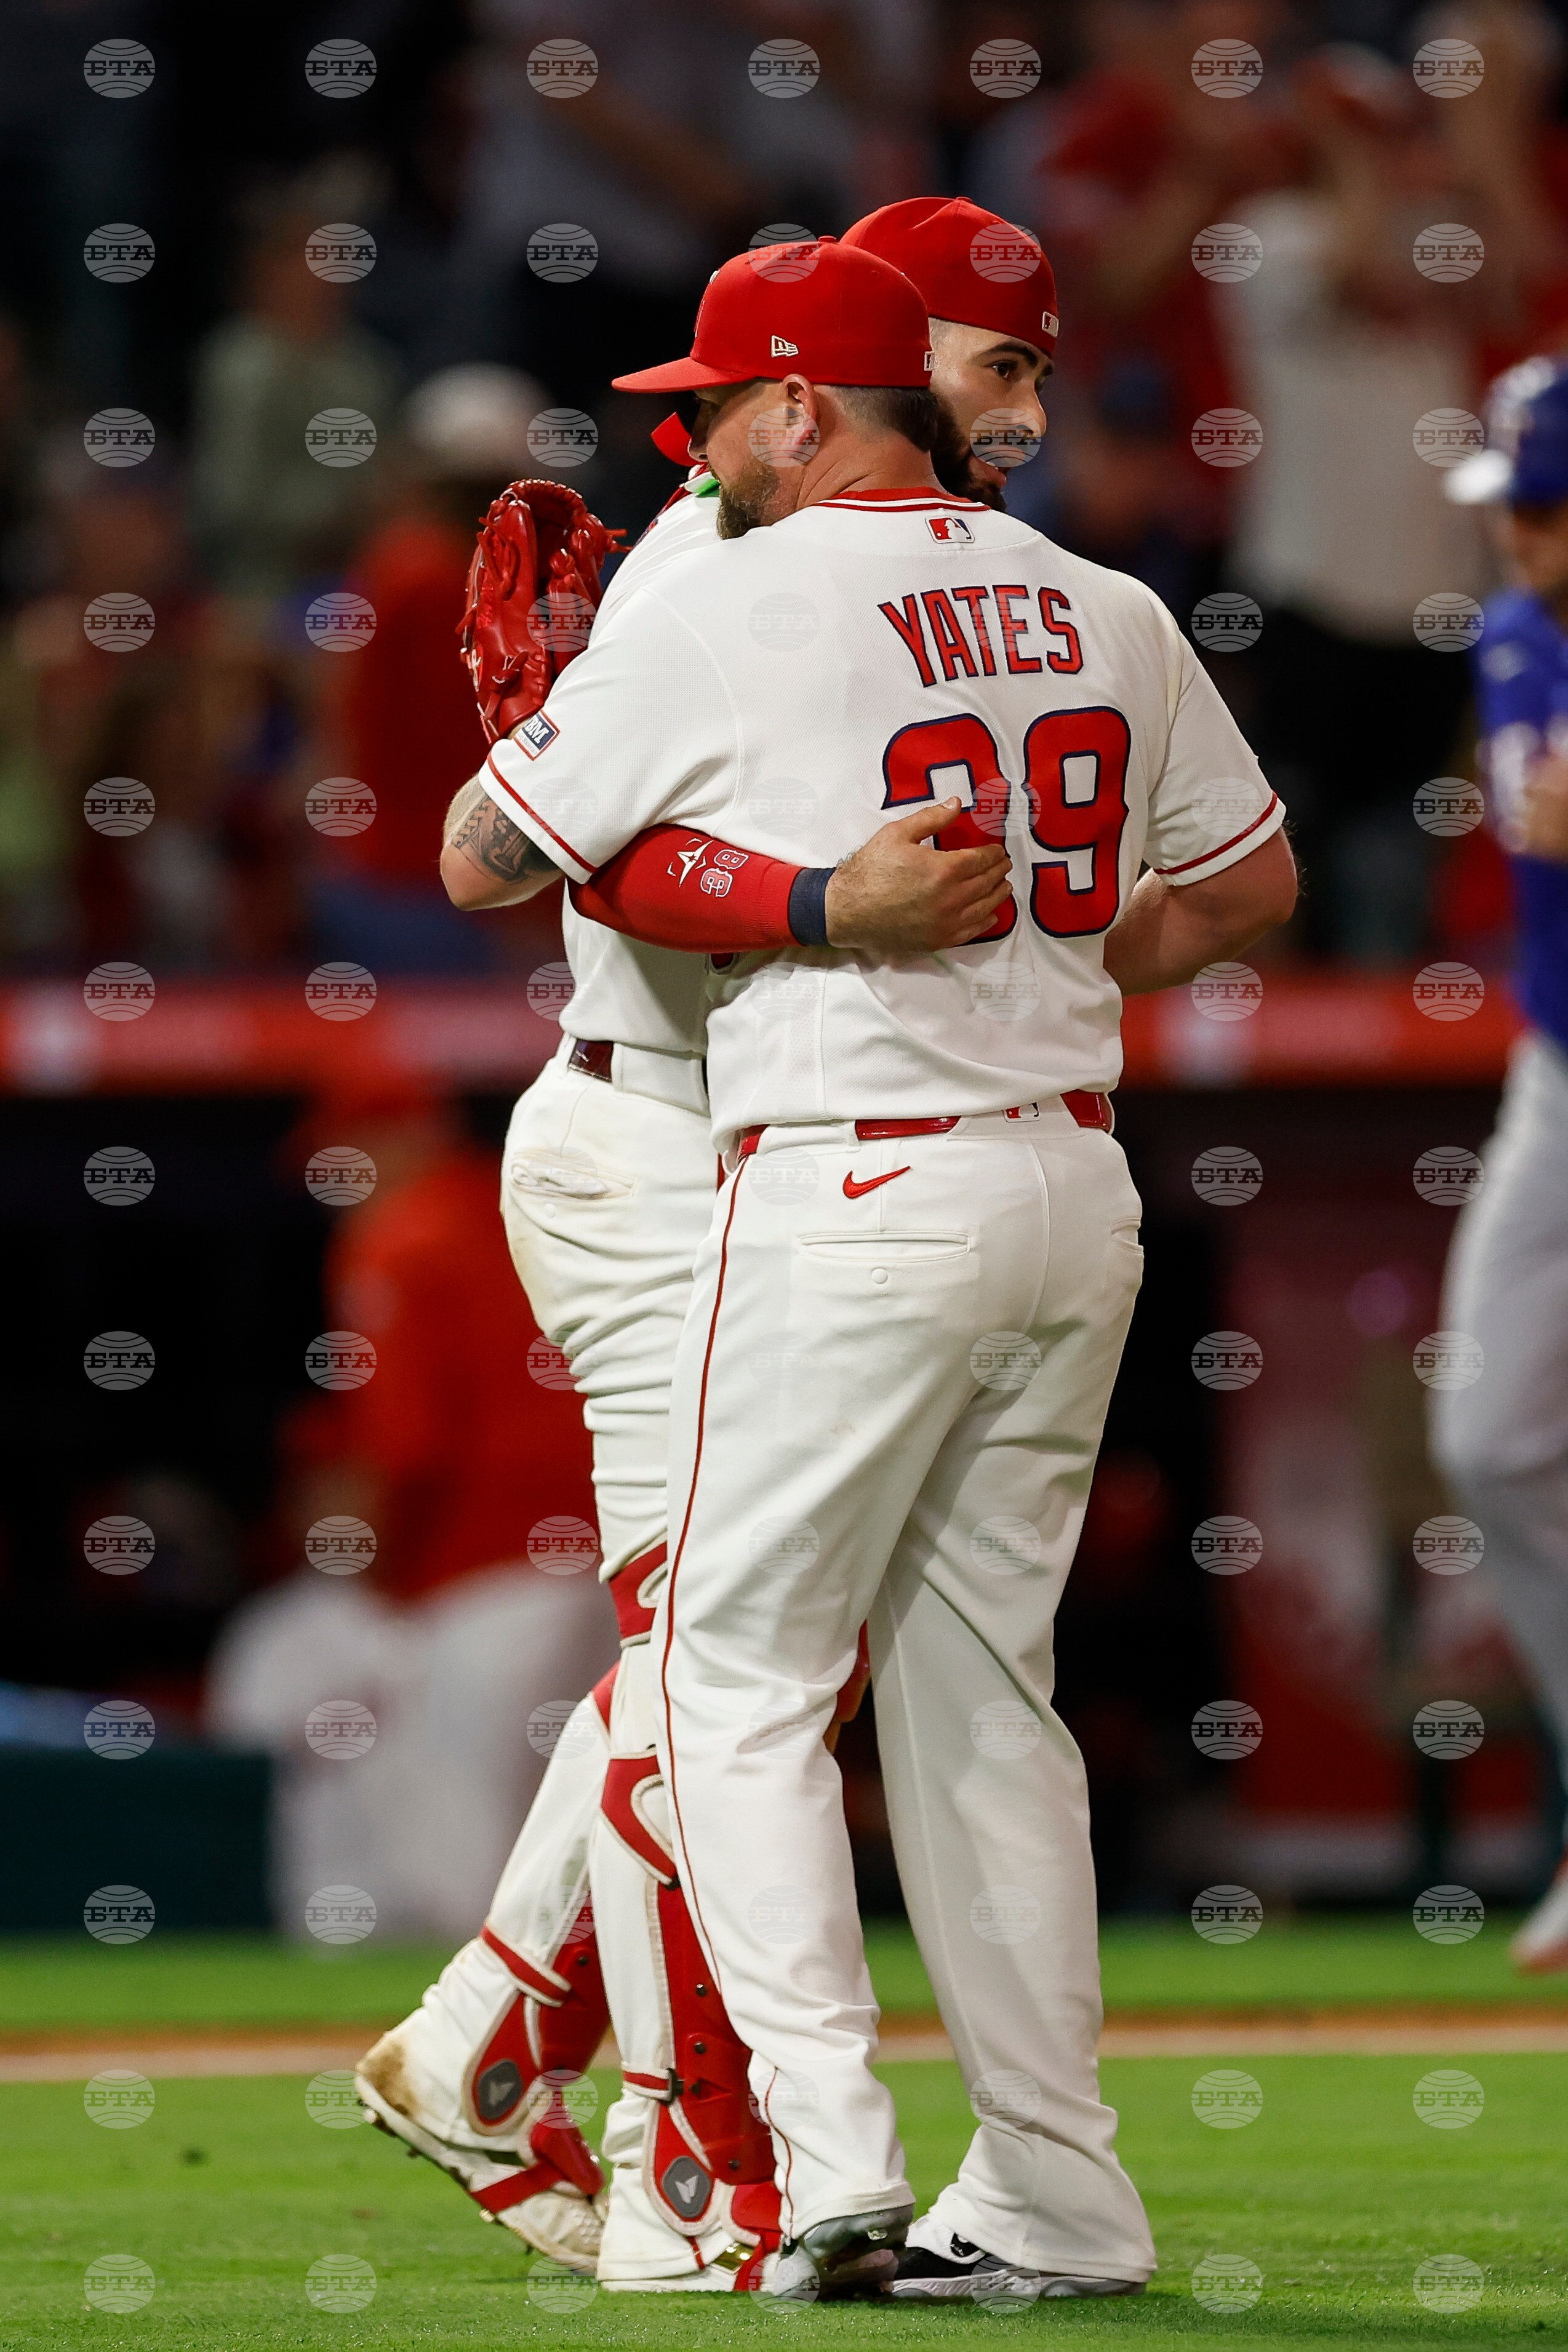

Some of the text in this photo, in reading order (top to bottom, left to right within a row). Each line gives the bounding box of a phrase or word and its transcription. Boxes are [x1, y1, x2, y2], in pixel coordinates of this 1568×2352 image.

[878, 584, 1084, 688] YATES
[523, 714, 550, 744] BM
[881, 705, 1131, 946] 39
[700, 849, 749, 897] 38
